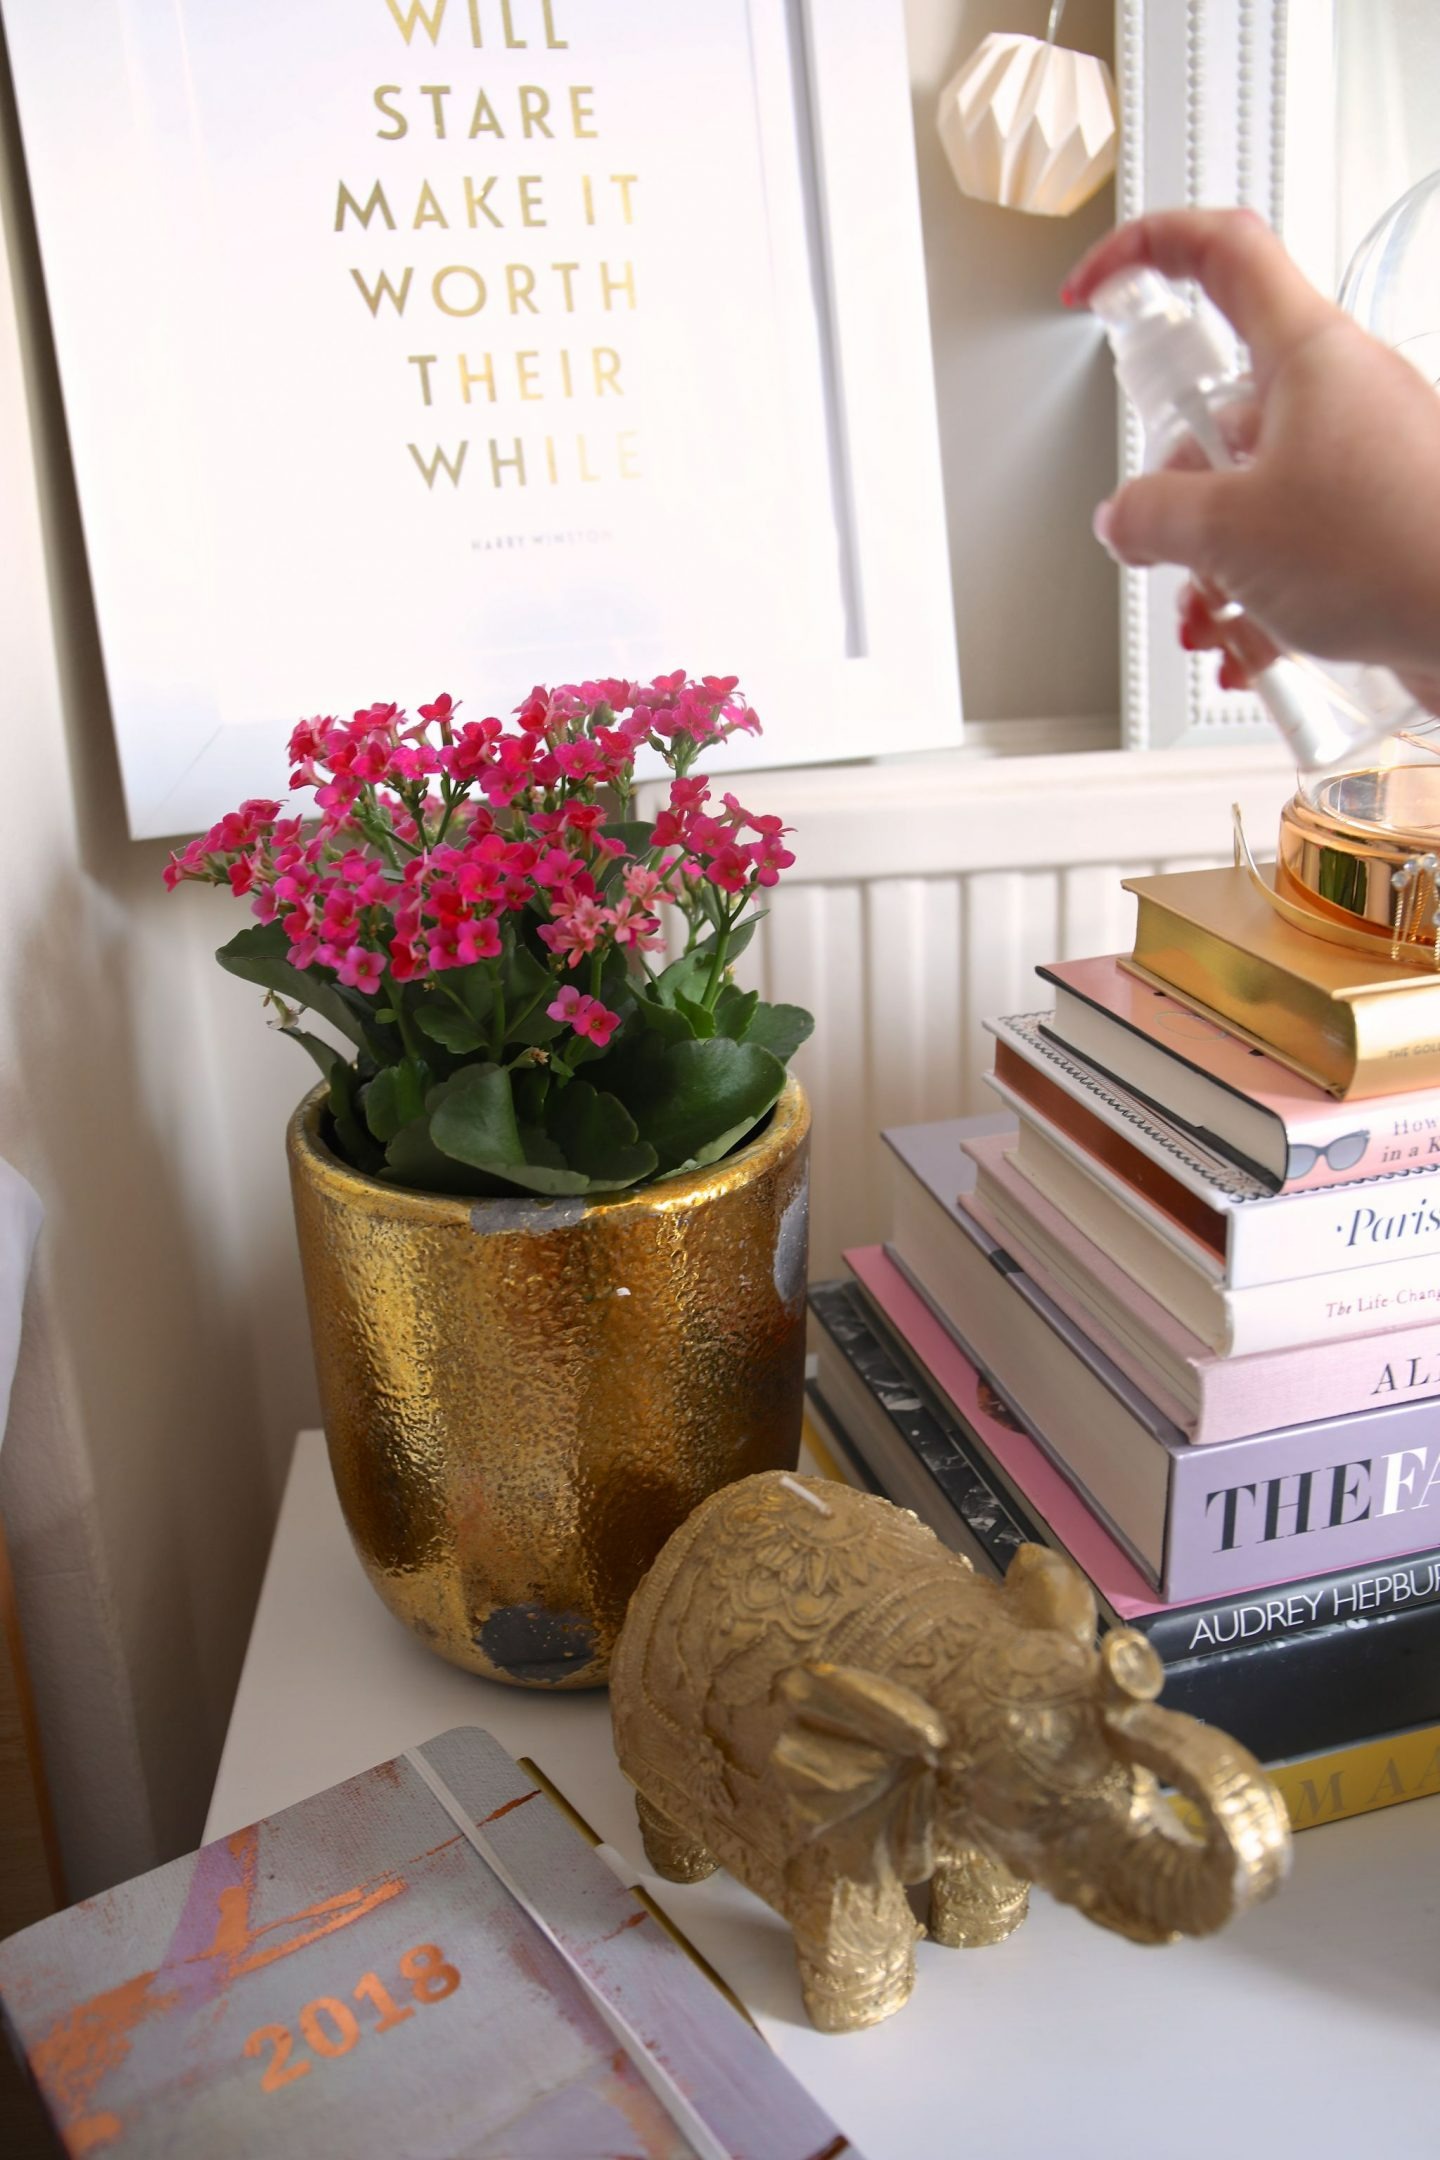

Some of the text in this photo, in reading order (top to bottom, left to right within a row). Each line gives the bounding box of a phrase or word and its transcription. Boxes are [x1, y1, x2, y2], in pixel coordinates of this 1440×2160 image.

[384, 0, 568, 49] WILL
[373, 84, 599, 140] STARE
[334, 174, 638, 232] MAKE IT
[349, 260, 637, 319] WORTH
[407, 347, 625, 406] THEIR
[406, 430, 642, 491] WHILE
[1381, 1146, 1402, 1163] in
[1408, 1146, 1420, 1158] a
[1370, 1353, 1440, 1396] AL
[1189, 1590, 1325, 1650] AUDREY
[244, 1943, 461, 2093] 2018
